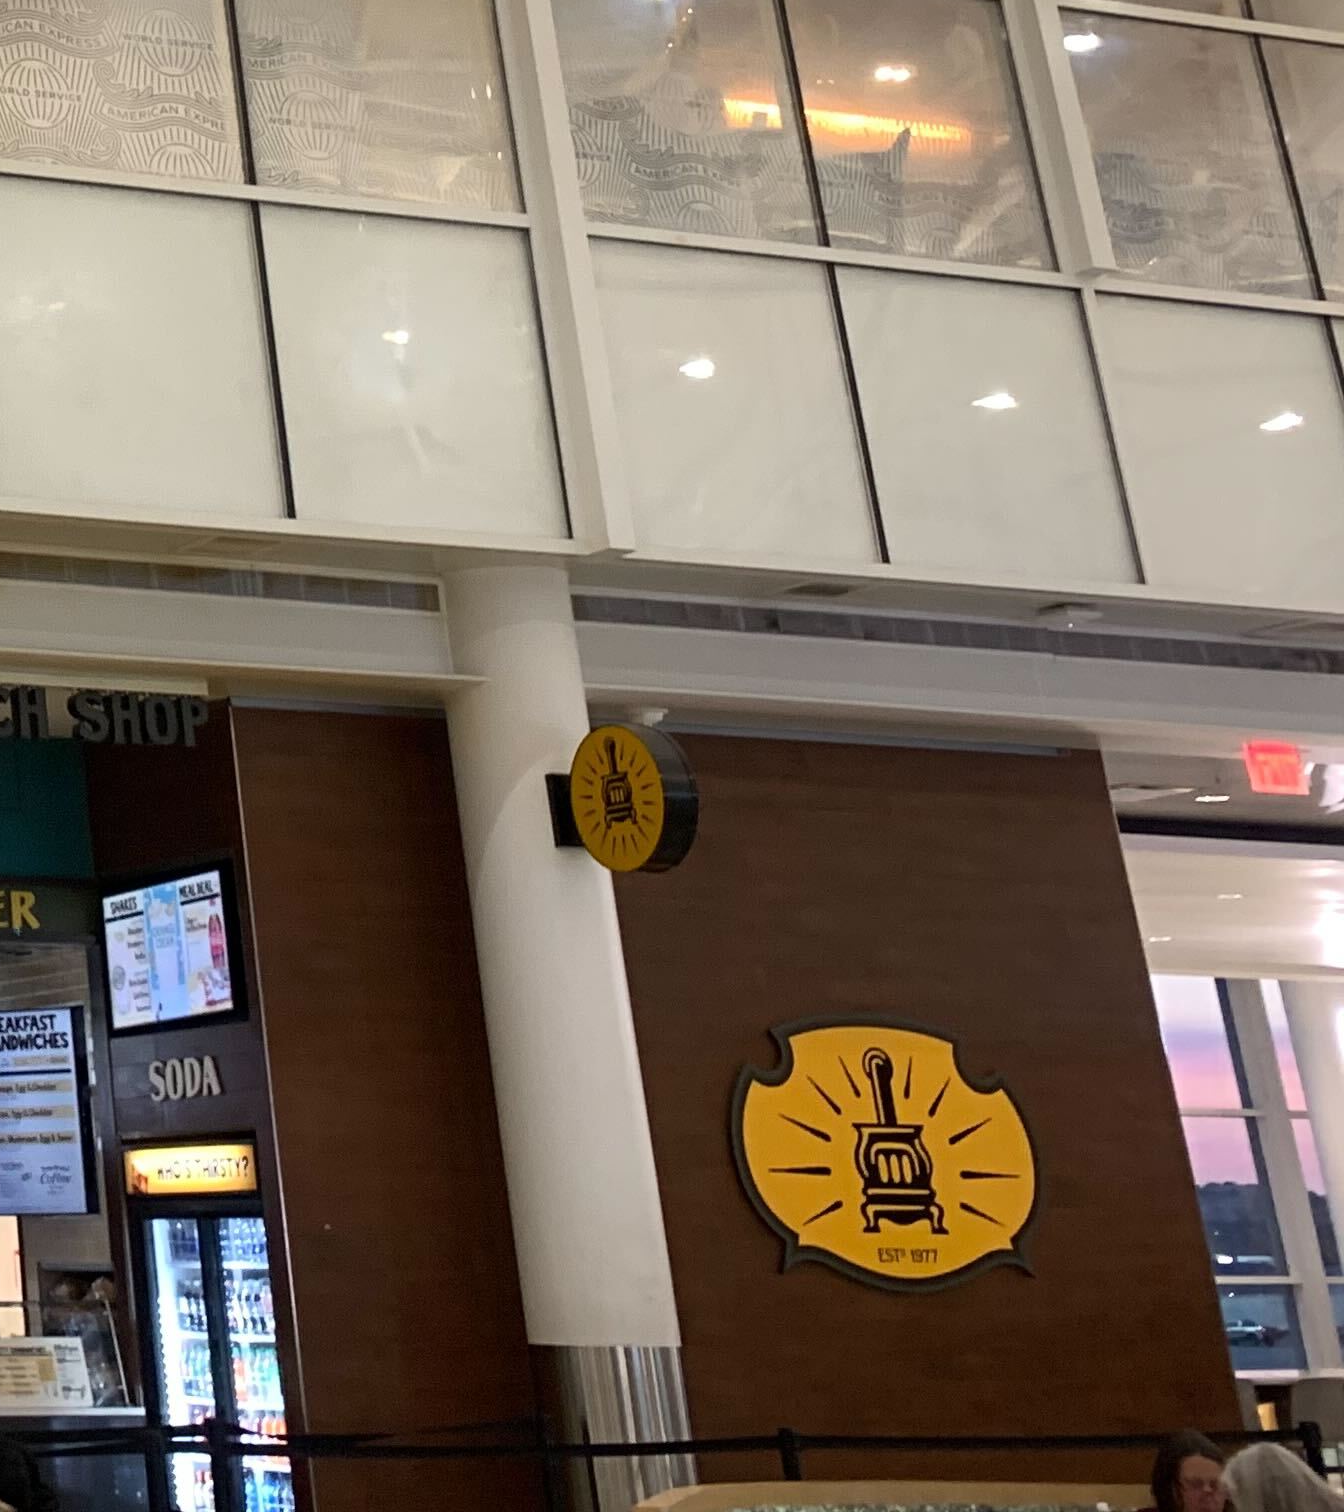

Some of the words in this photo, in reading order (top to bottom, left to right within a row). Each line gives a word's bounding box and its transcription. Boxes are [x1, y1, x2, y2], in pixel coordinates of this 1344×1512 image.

[38, 24, 102, 49] EXPRESS
[122, 32, 162, 45] WORLD
[166, 38, 213, 52] SERVICE
[35, 89, 83, 103] SERVICE
[107, 105, 180, 121] AMERICAN
[633, 163, 699, 179] AMERICAN
[70, 690, 210, 747] SHOP
[149, 1056, 221, 1102] SODA
[911, 1248, 939, 1264] 1977
